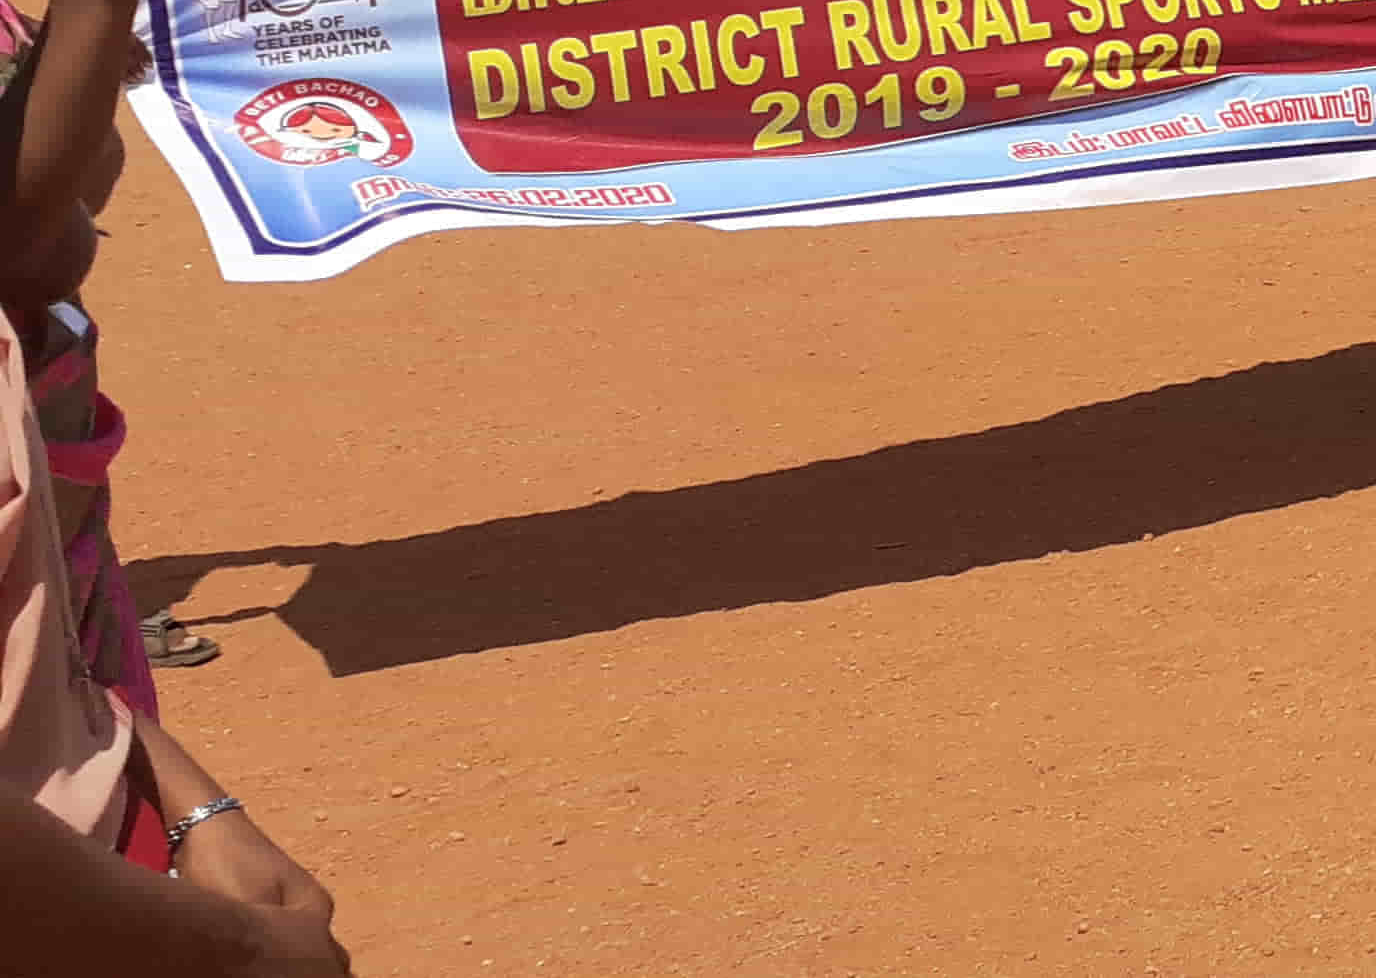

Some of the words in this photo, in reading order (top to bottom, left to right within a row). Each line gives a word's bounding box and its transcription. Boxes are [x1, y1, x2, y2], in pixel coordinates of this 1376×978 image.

[252, 20, 315, 37] YEARS
[319, 15, 345, 29] OF
[254, 26, 383, 50] CELEBRATING
[256, 50, 296, 67] THE
[299, 40, 392, 63] MAHATMA
[467, 6, 806, 120] DISTRICT
[751, 65, 966, 150] 2019
[995, 84, 1021, 99] -
[1044, 27, 1222, 103] 2020
[1219, 87, 1372, 130] விளையாட்டு
